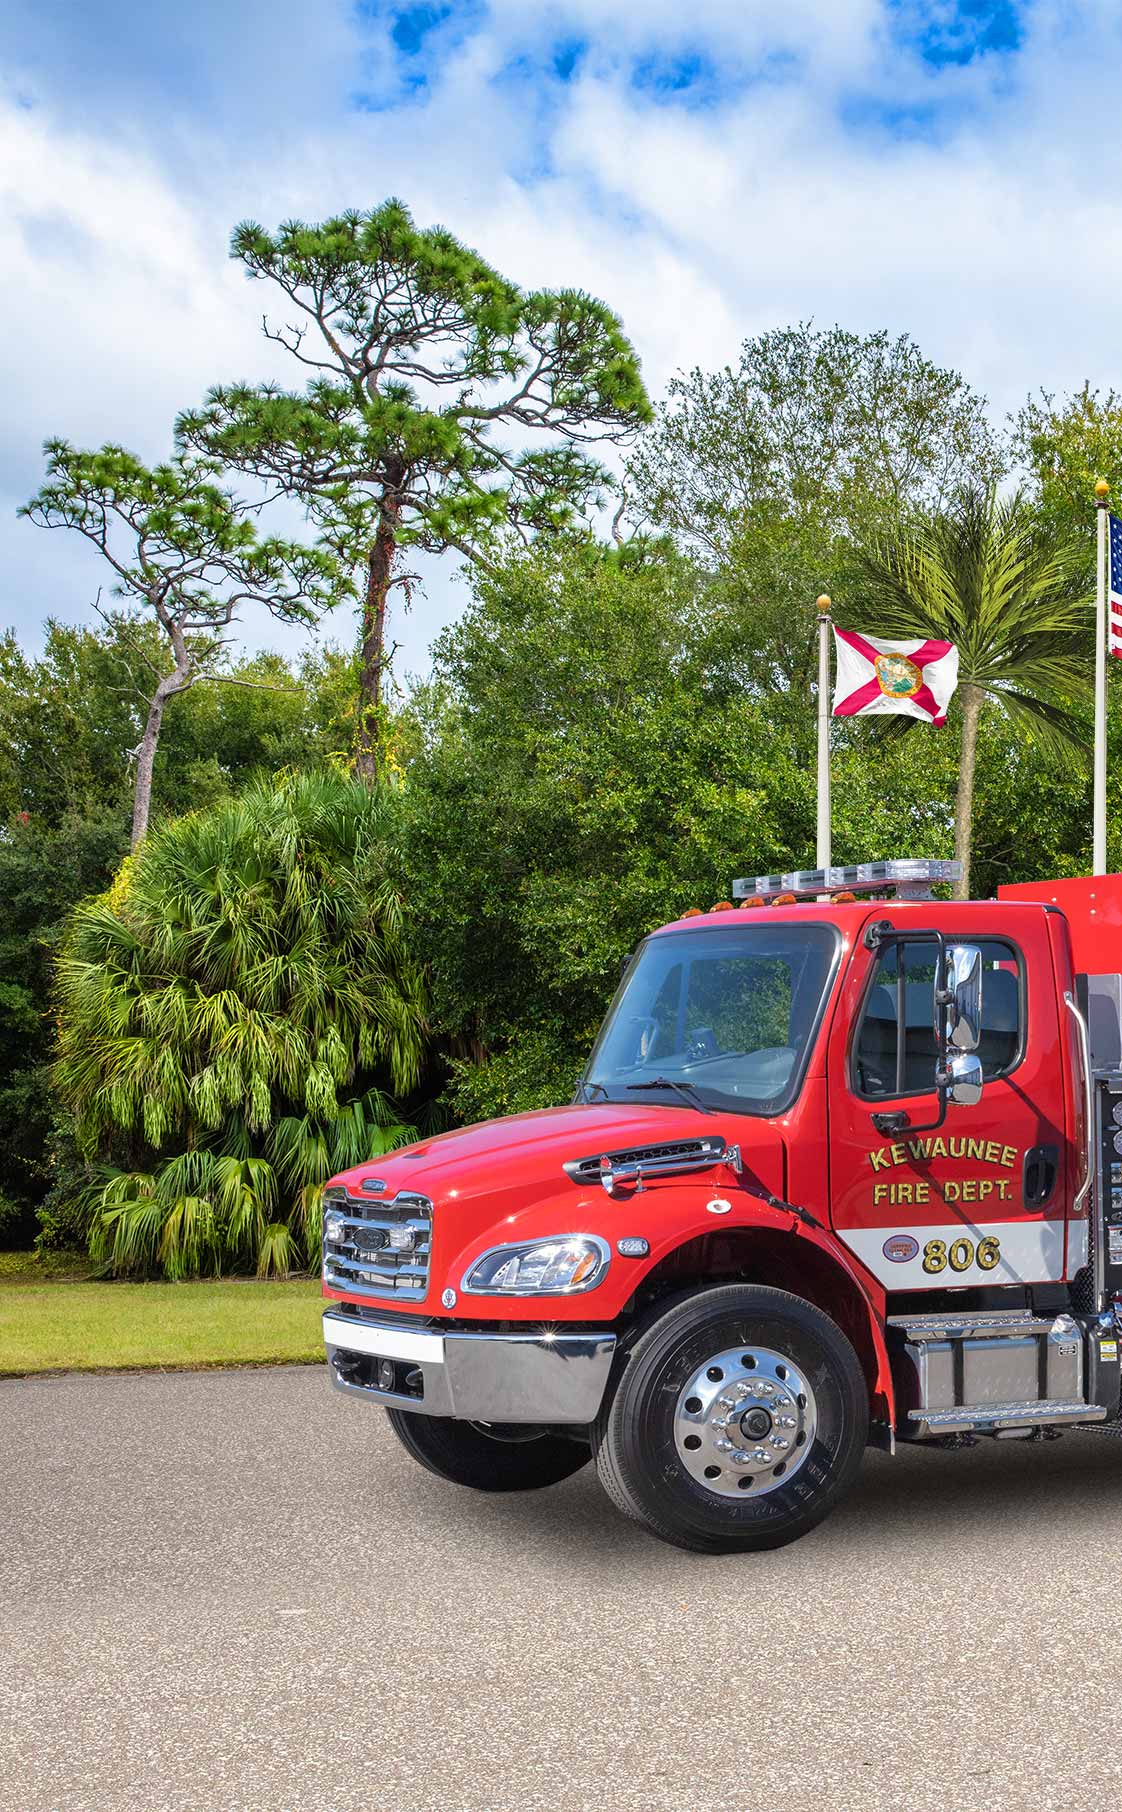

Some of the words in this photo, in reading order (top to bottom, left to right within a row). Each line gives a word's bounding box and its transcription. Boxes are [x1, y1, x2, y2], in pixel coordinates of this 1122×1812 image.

[869, 1137, 1018, 1172] KEWAUNEE
[873, 1183, 930, 1206] FIRE
[944, 1180, 1013, 1203] DEPT.
[922, 1236, 1001, 1274] 806
